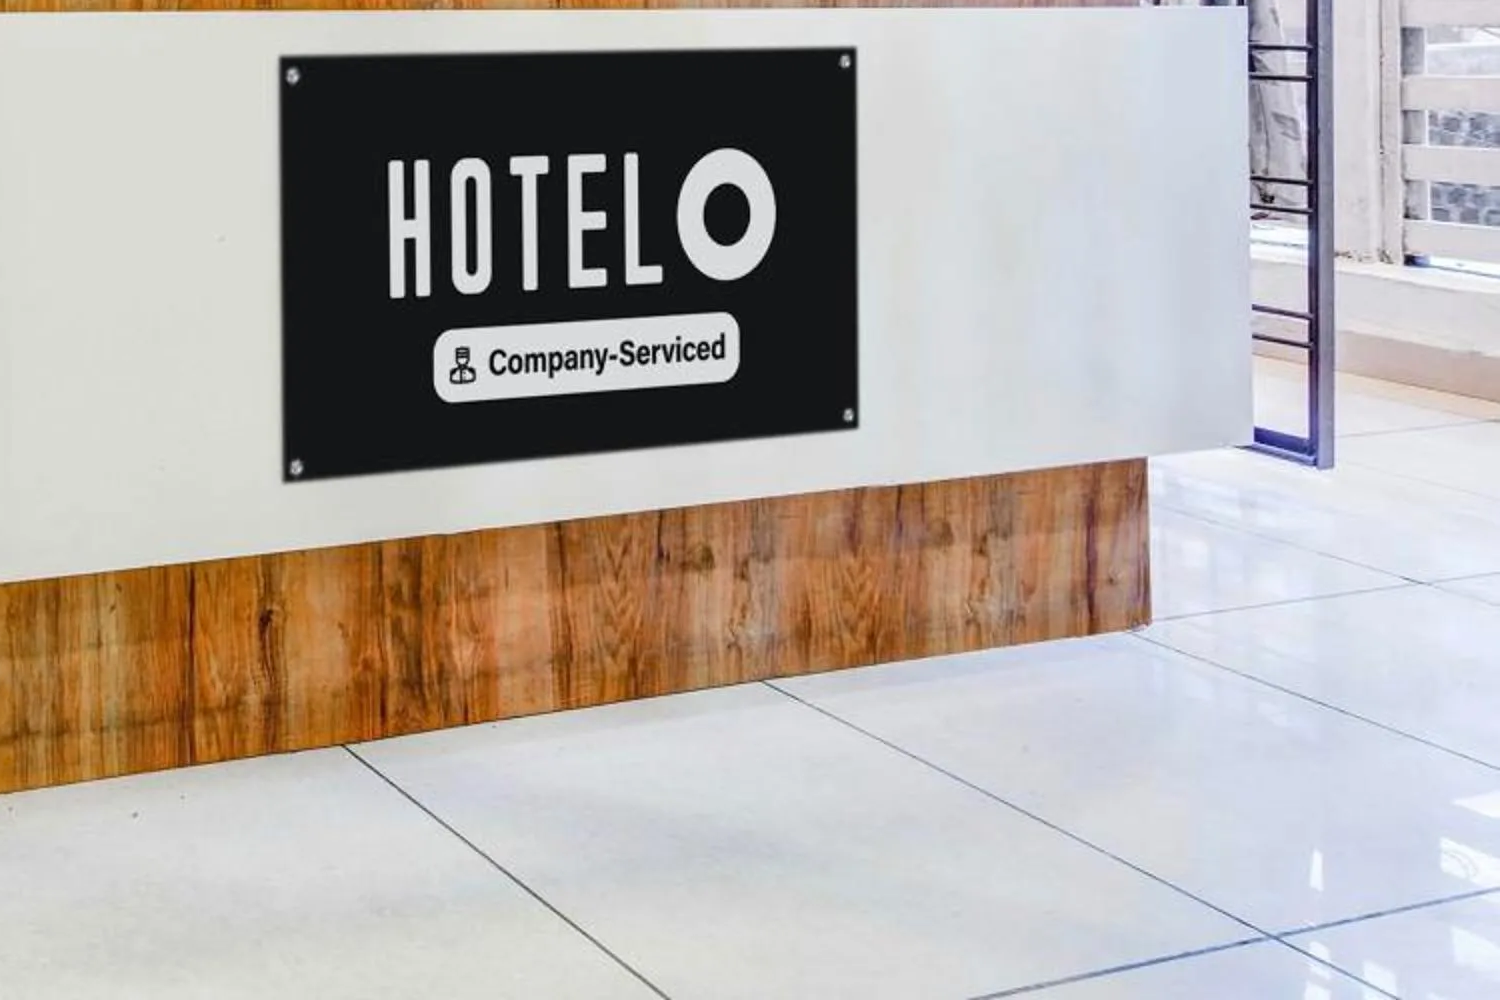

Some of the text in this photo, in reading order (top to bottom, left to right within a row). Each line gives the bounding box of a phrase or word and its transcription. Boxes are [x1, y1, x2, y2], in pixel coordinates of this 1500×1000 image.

[387, 147, 777, 299] HOTEL O
[487, 332, 727, 379] Company-Serviced
